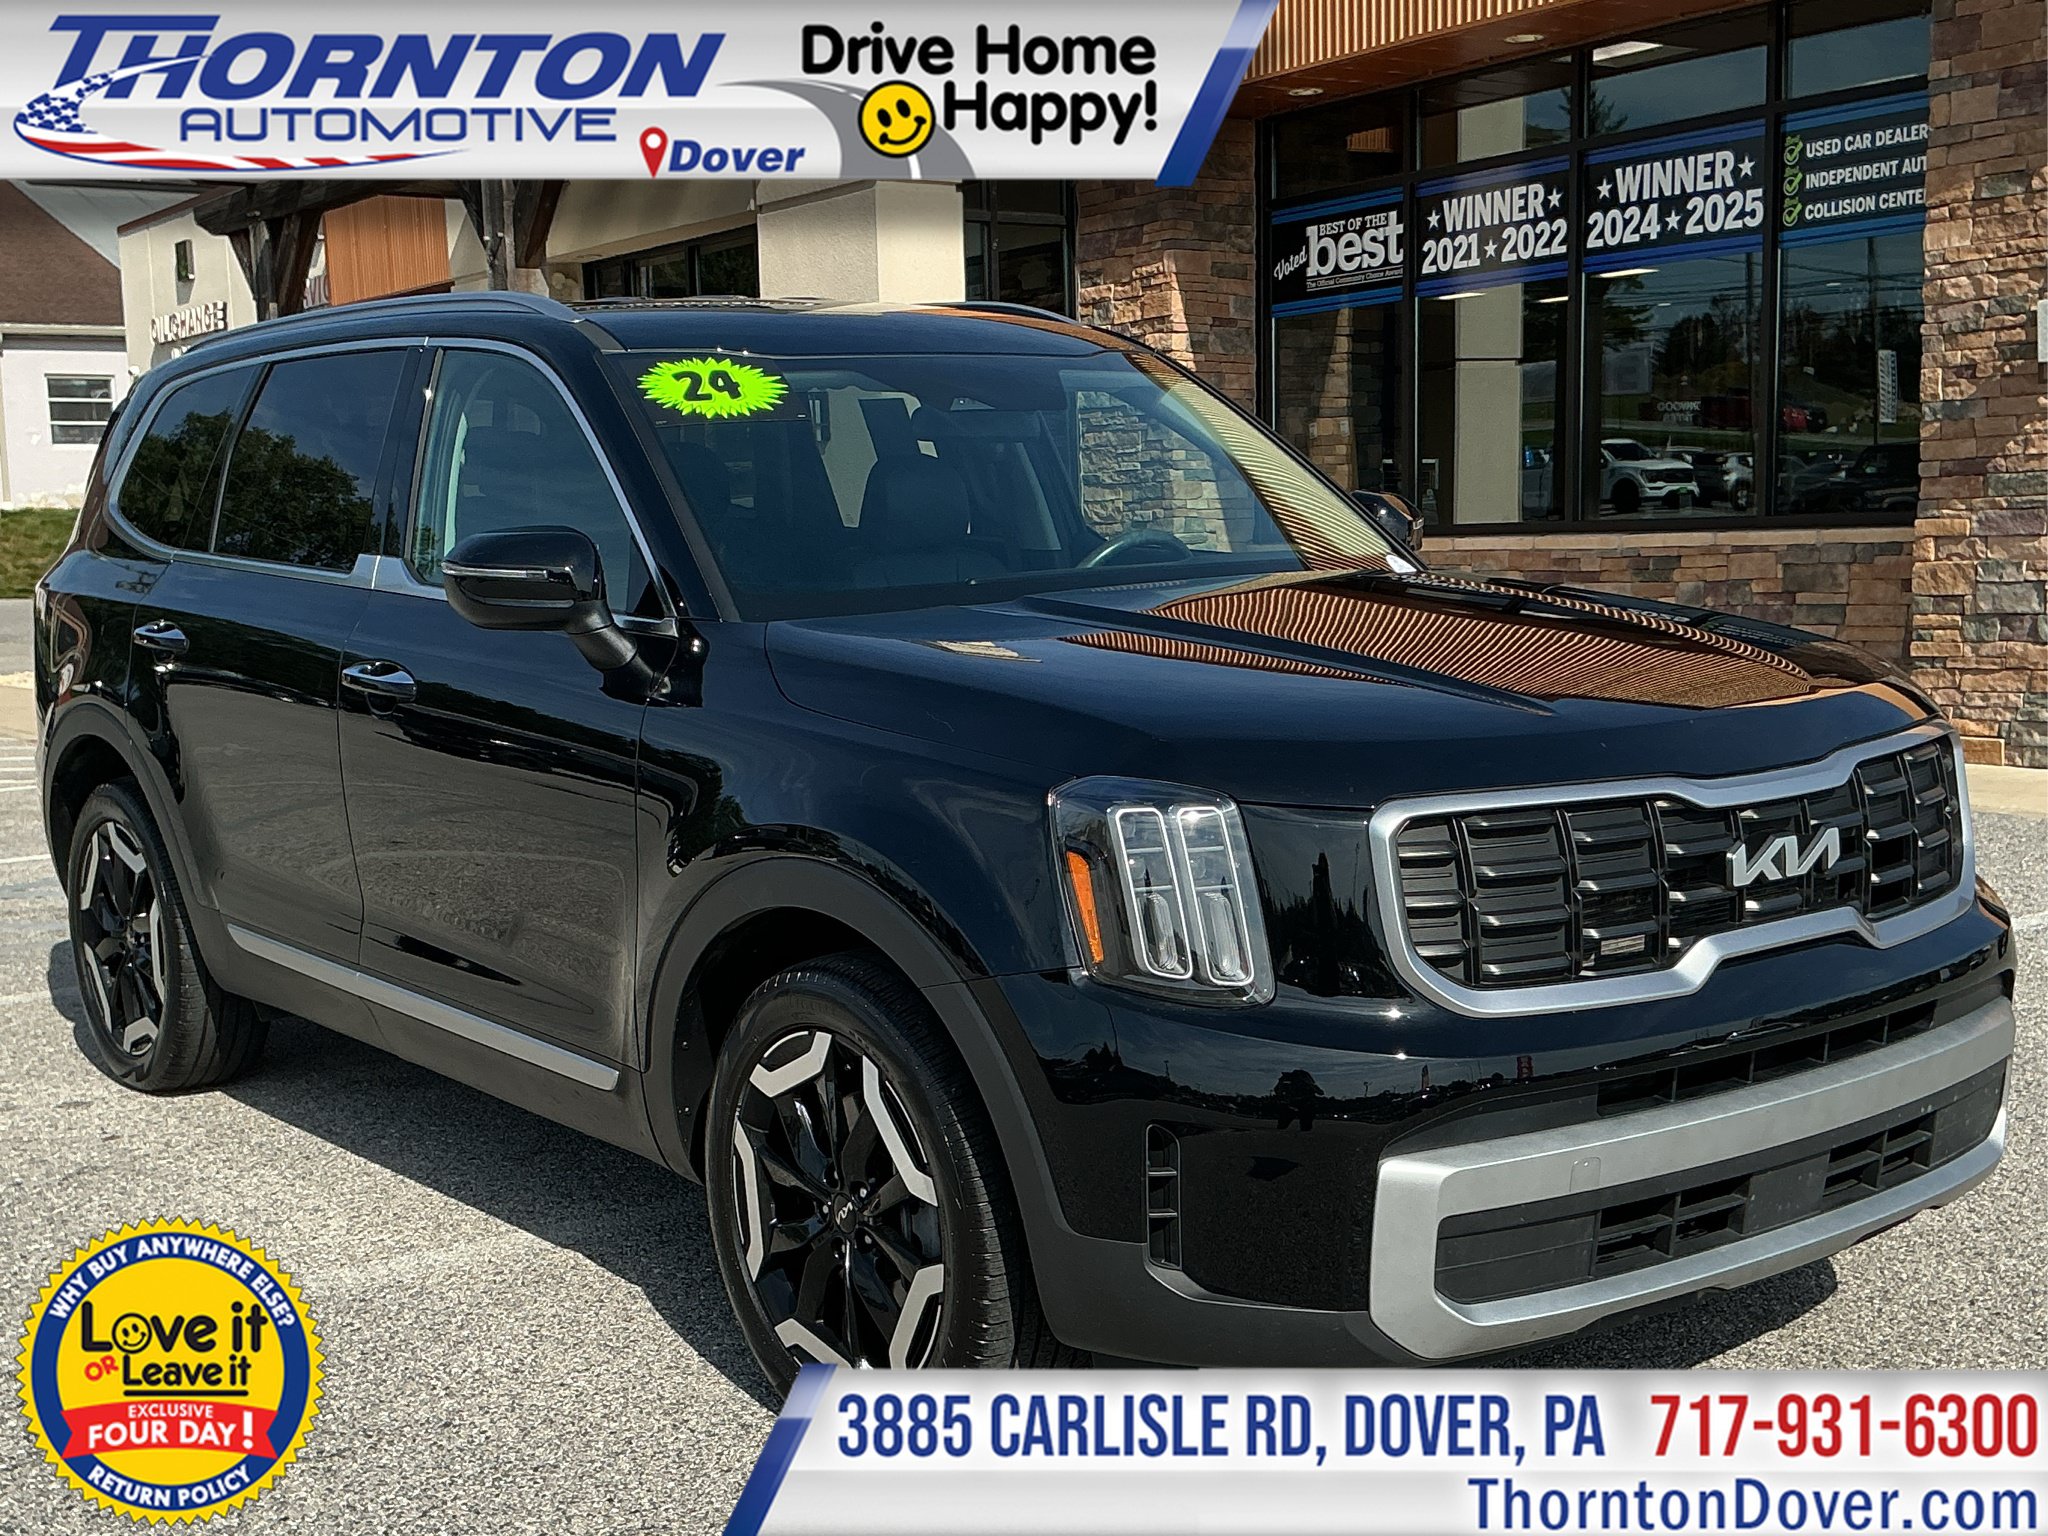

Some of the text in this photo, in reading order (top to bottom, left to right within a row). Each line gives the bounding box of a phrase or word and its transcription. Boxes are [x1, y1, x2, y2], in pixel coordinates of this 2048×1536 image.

[1806, 123, 1933, 158] USED CAR DEALER
[1615, 150, 1736, 204] WINNER
[1805, 160, 1899, 189] INDEPENDENT
[1319, 212, 1388, 236] BEST OF THE
[1442, 183, 1546, 234] WINNER
[1586, 187, 1764, 249] 2024 2025
[1804, 195, 1876, 220] COLLISION
[1273, 245, 1308, 280] Voted
[1305, 209, 1404, 278] best
[1421, 218, 1568, 275] 2021 2022
[671, 369, 742, 402] 24
[1726, 826, 1842, 888] KIA
